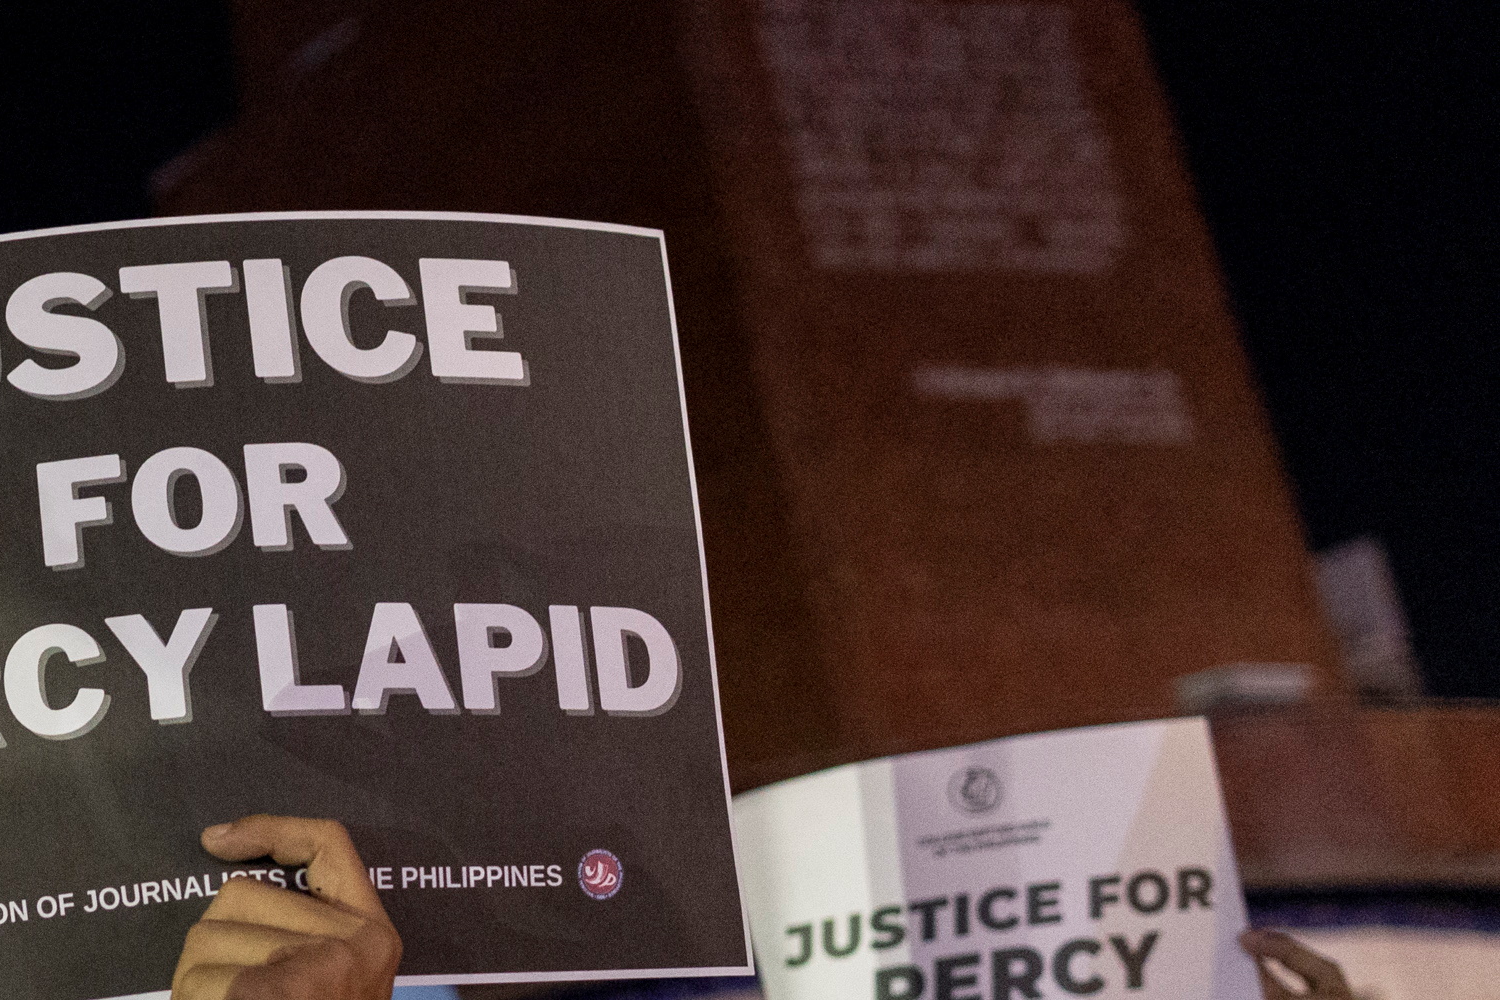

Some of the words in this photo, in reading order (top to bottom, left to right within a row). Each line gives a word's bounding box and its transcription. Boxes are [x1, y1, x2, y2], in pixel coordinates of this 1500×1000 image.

[35, 441, 353, 571] FOR
[251, 601, 684, 717] LAPID
[36, 892, 75, 919] OF
[83, 868, 287, 913] JOURNALTS
[401, 864, 564, 889] PHILIPPINES
[784, 881, 1063, 969] JUSTICE
[1088, 866, 1215, 921] FOR
